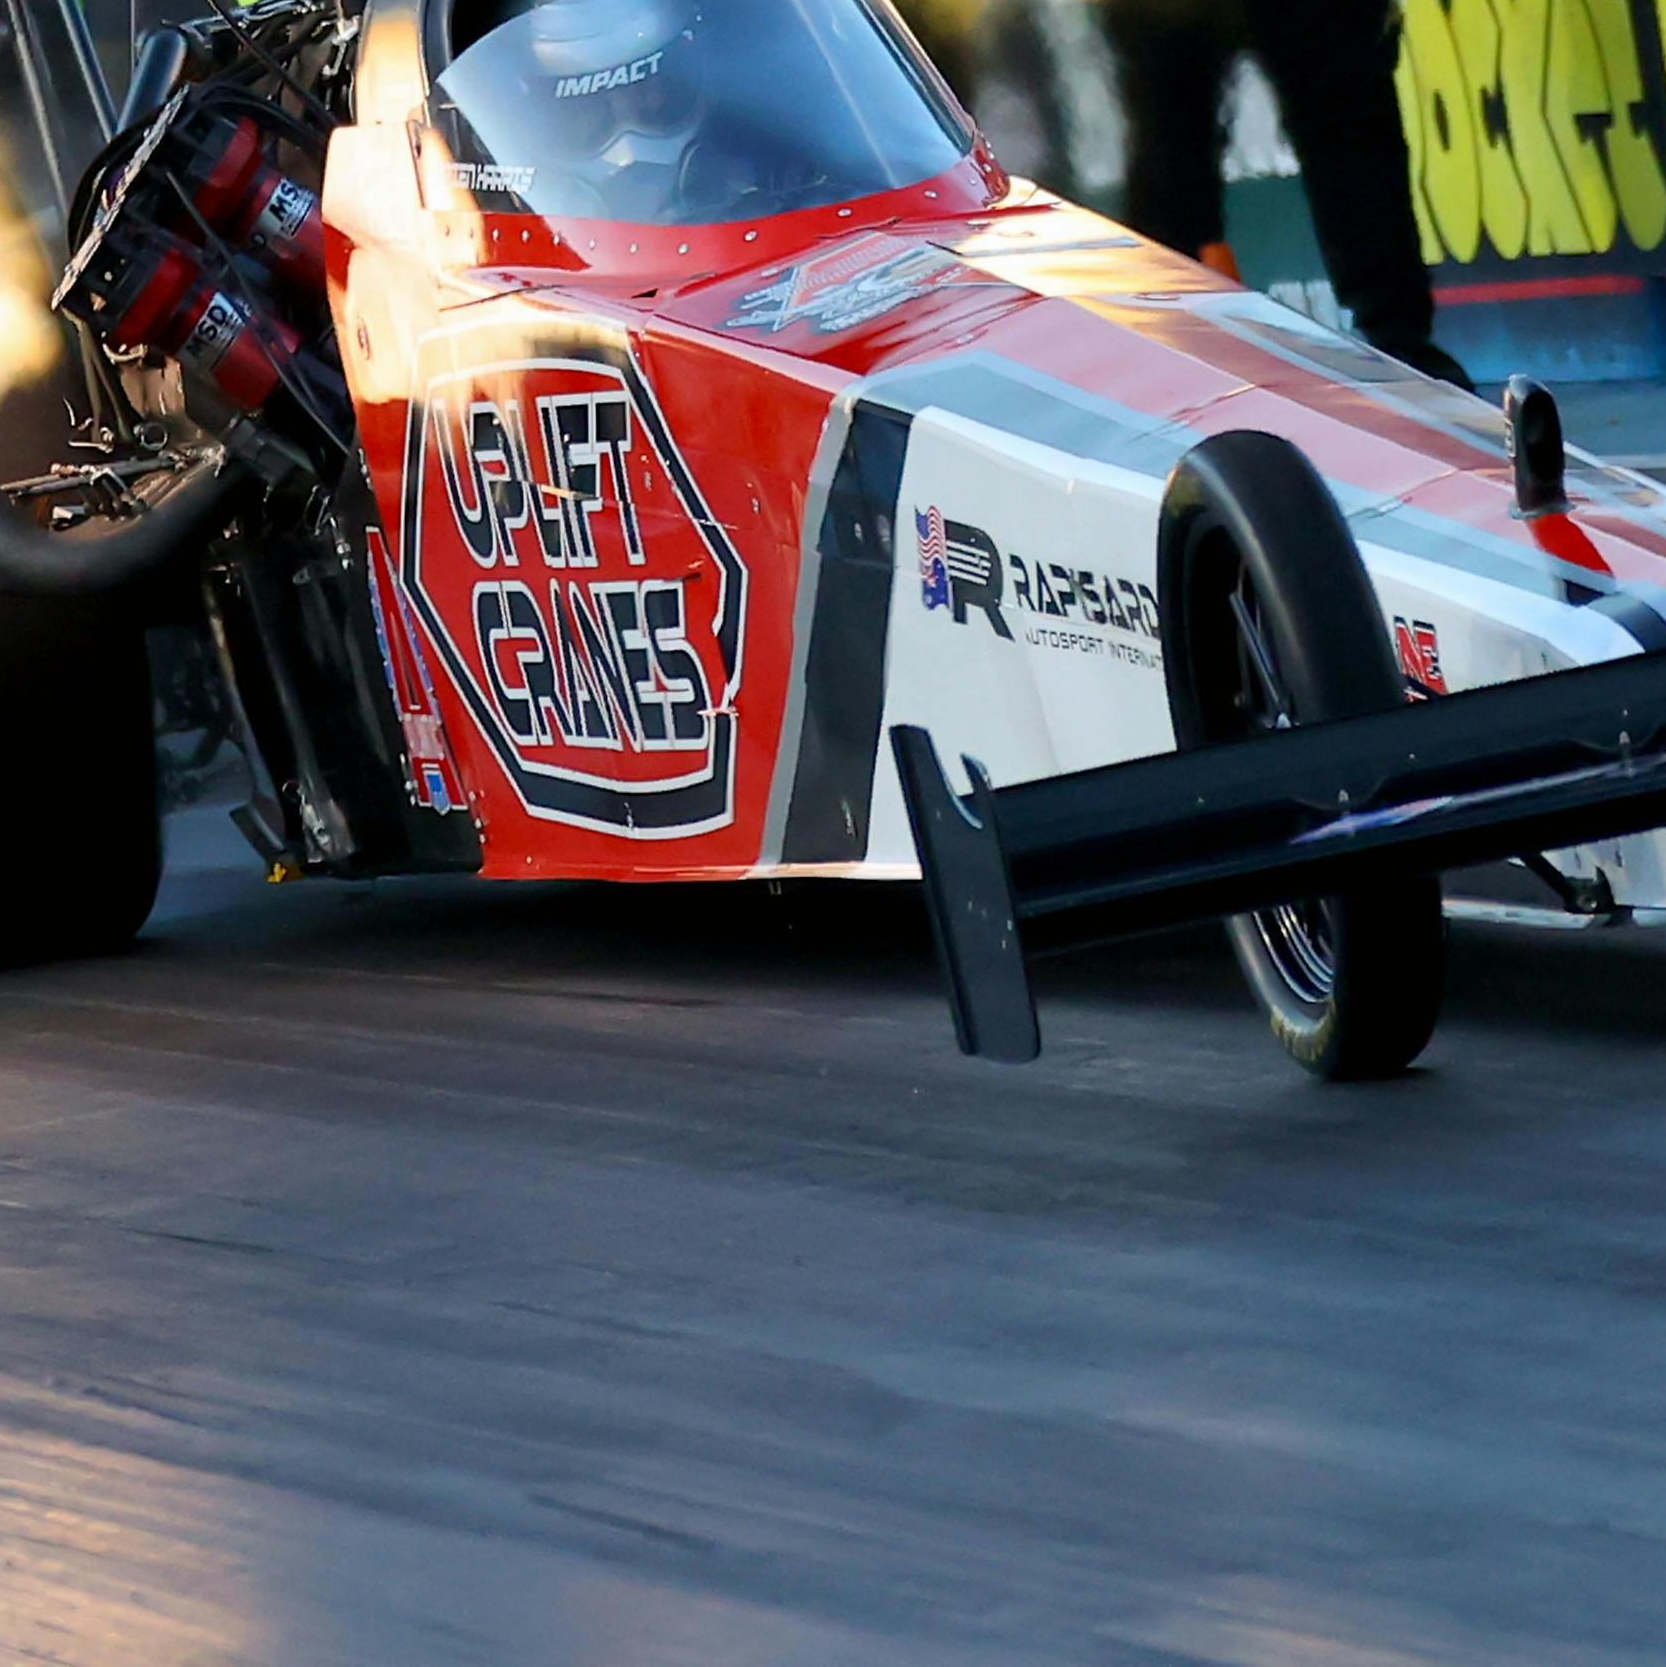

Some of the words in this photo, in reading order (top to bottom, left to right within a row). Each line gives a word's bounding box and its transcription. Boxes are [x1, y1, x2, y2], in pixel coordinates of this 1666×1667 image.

[554, 51, 664, 99] IMPACT
[432, 390, 646, 569] UPLIFT
[472, 577, 711, 753] CRANES
